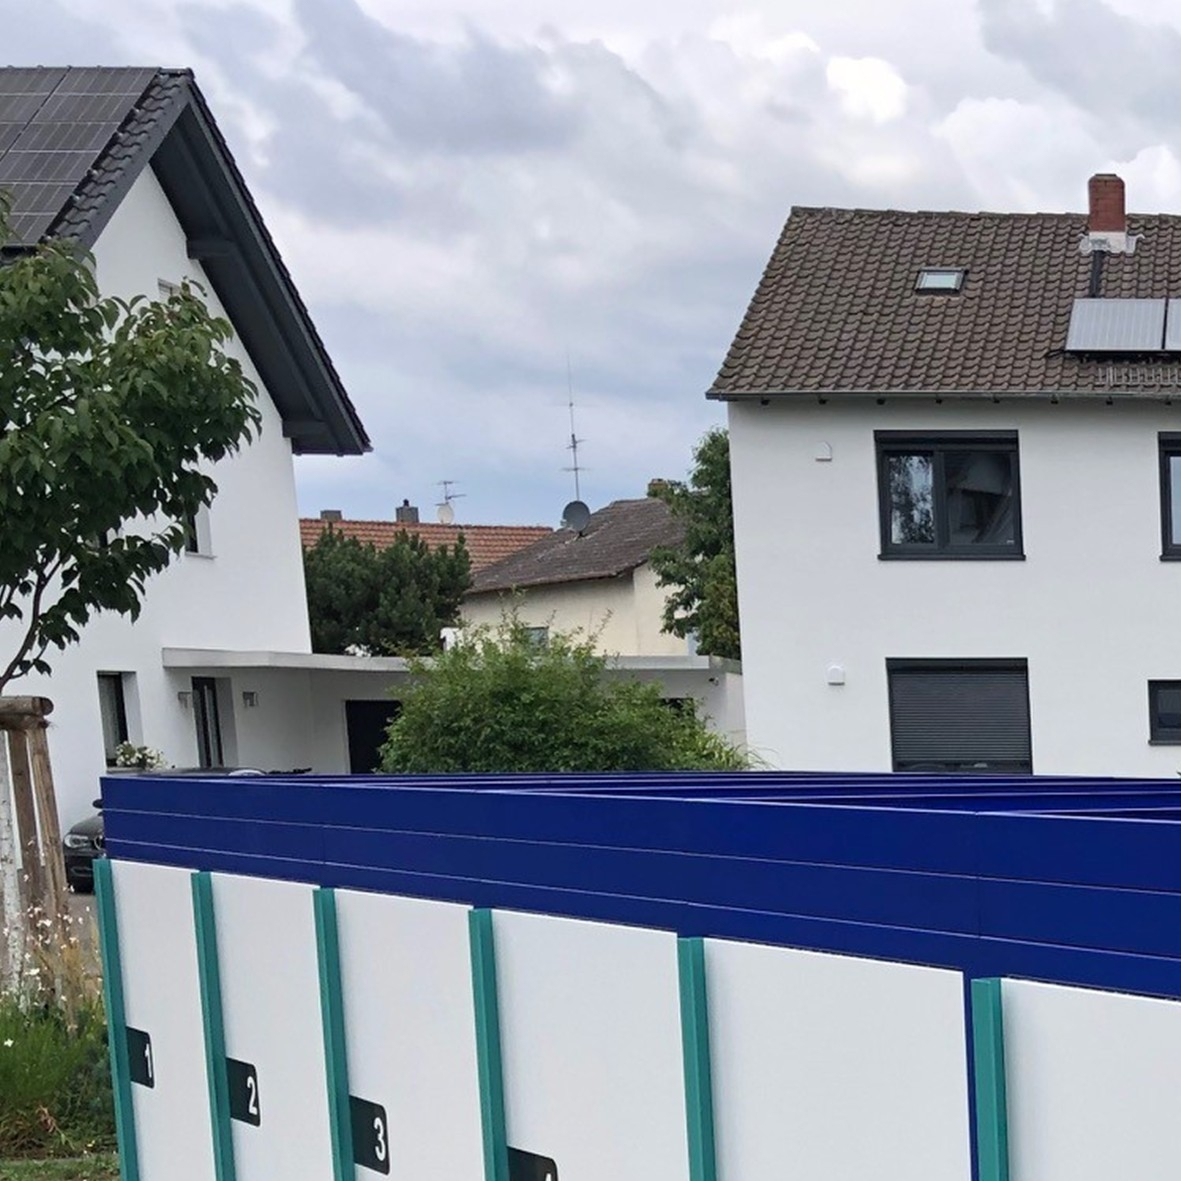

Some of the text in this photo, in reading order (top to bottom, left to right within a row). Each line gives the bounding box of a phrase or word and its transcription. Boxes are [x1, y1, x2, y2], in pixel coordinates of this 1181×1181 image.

[145, 1043, 152, 1078] 1
[247, 1076, 258, 1115] 2
[374, 1117, 386, 1161] 3
